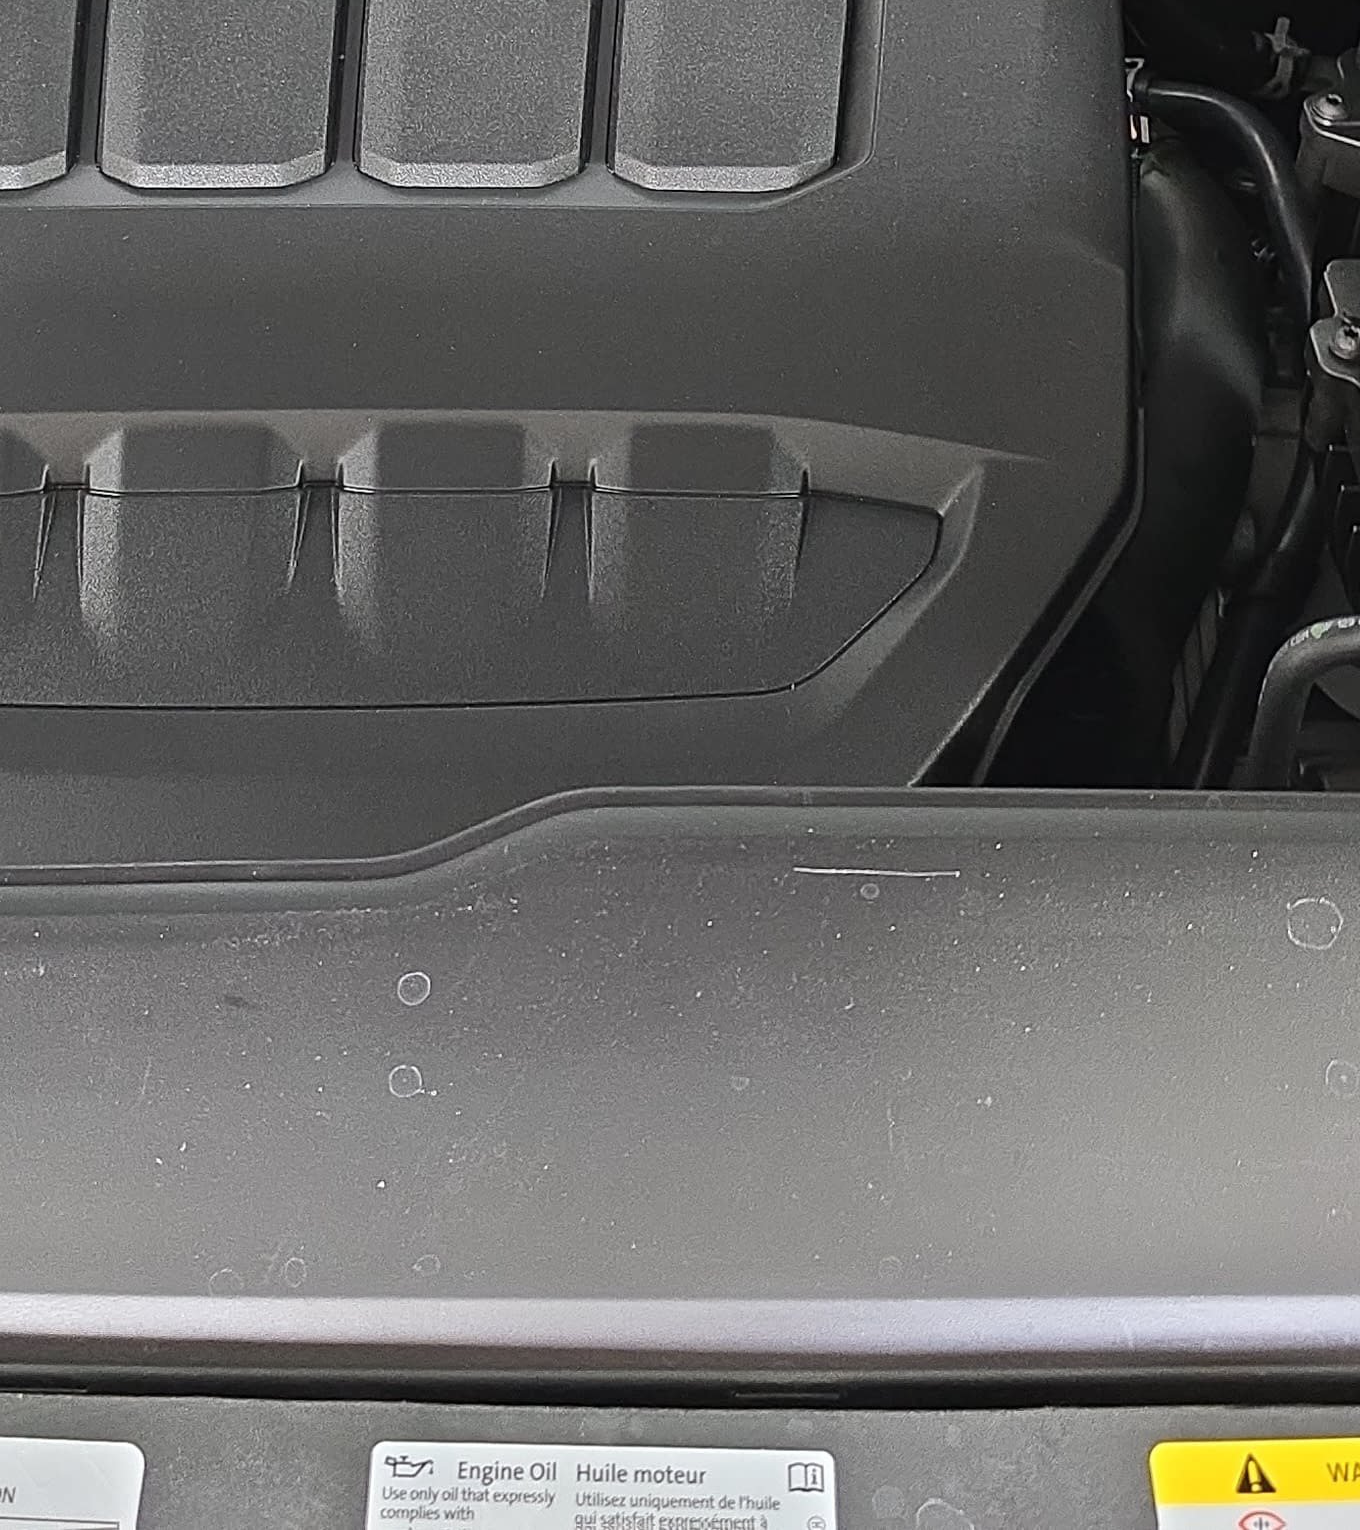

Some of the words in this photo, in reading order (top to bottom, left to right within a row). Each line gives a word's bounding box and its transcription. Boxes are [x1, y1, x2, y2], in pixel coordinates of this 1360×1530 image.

[457, 1461, 524, 1486] Engine
[529, 1461, 557, 1481] Oil
[576, 1463, 628, 1484] Huile
[633, 1465, 706, 1485] moteur
[382, 1486, 407, 1501] Use
[410, 1487, 439, 1505] only
[442, 1487, 458, 1501] oil
[462, 1488, 489, 1502] that
[493, 1489, 556, 1508] expressly
[575, 1492, 627, 1508] Utilisez
[630, 1493, 715, 1512] uniquement
[718, 1495, 737, 1510] de
[739, 1495, 781, 1511] l'huile
[380, 1505, 440, 1523] complies
[443, 1505, 475, 1521] with
